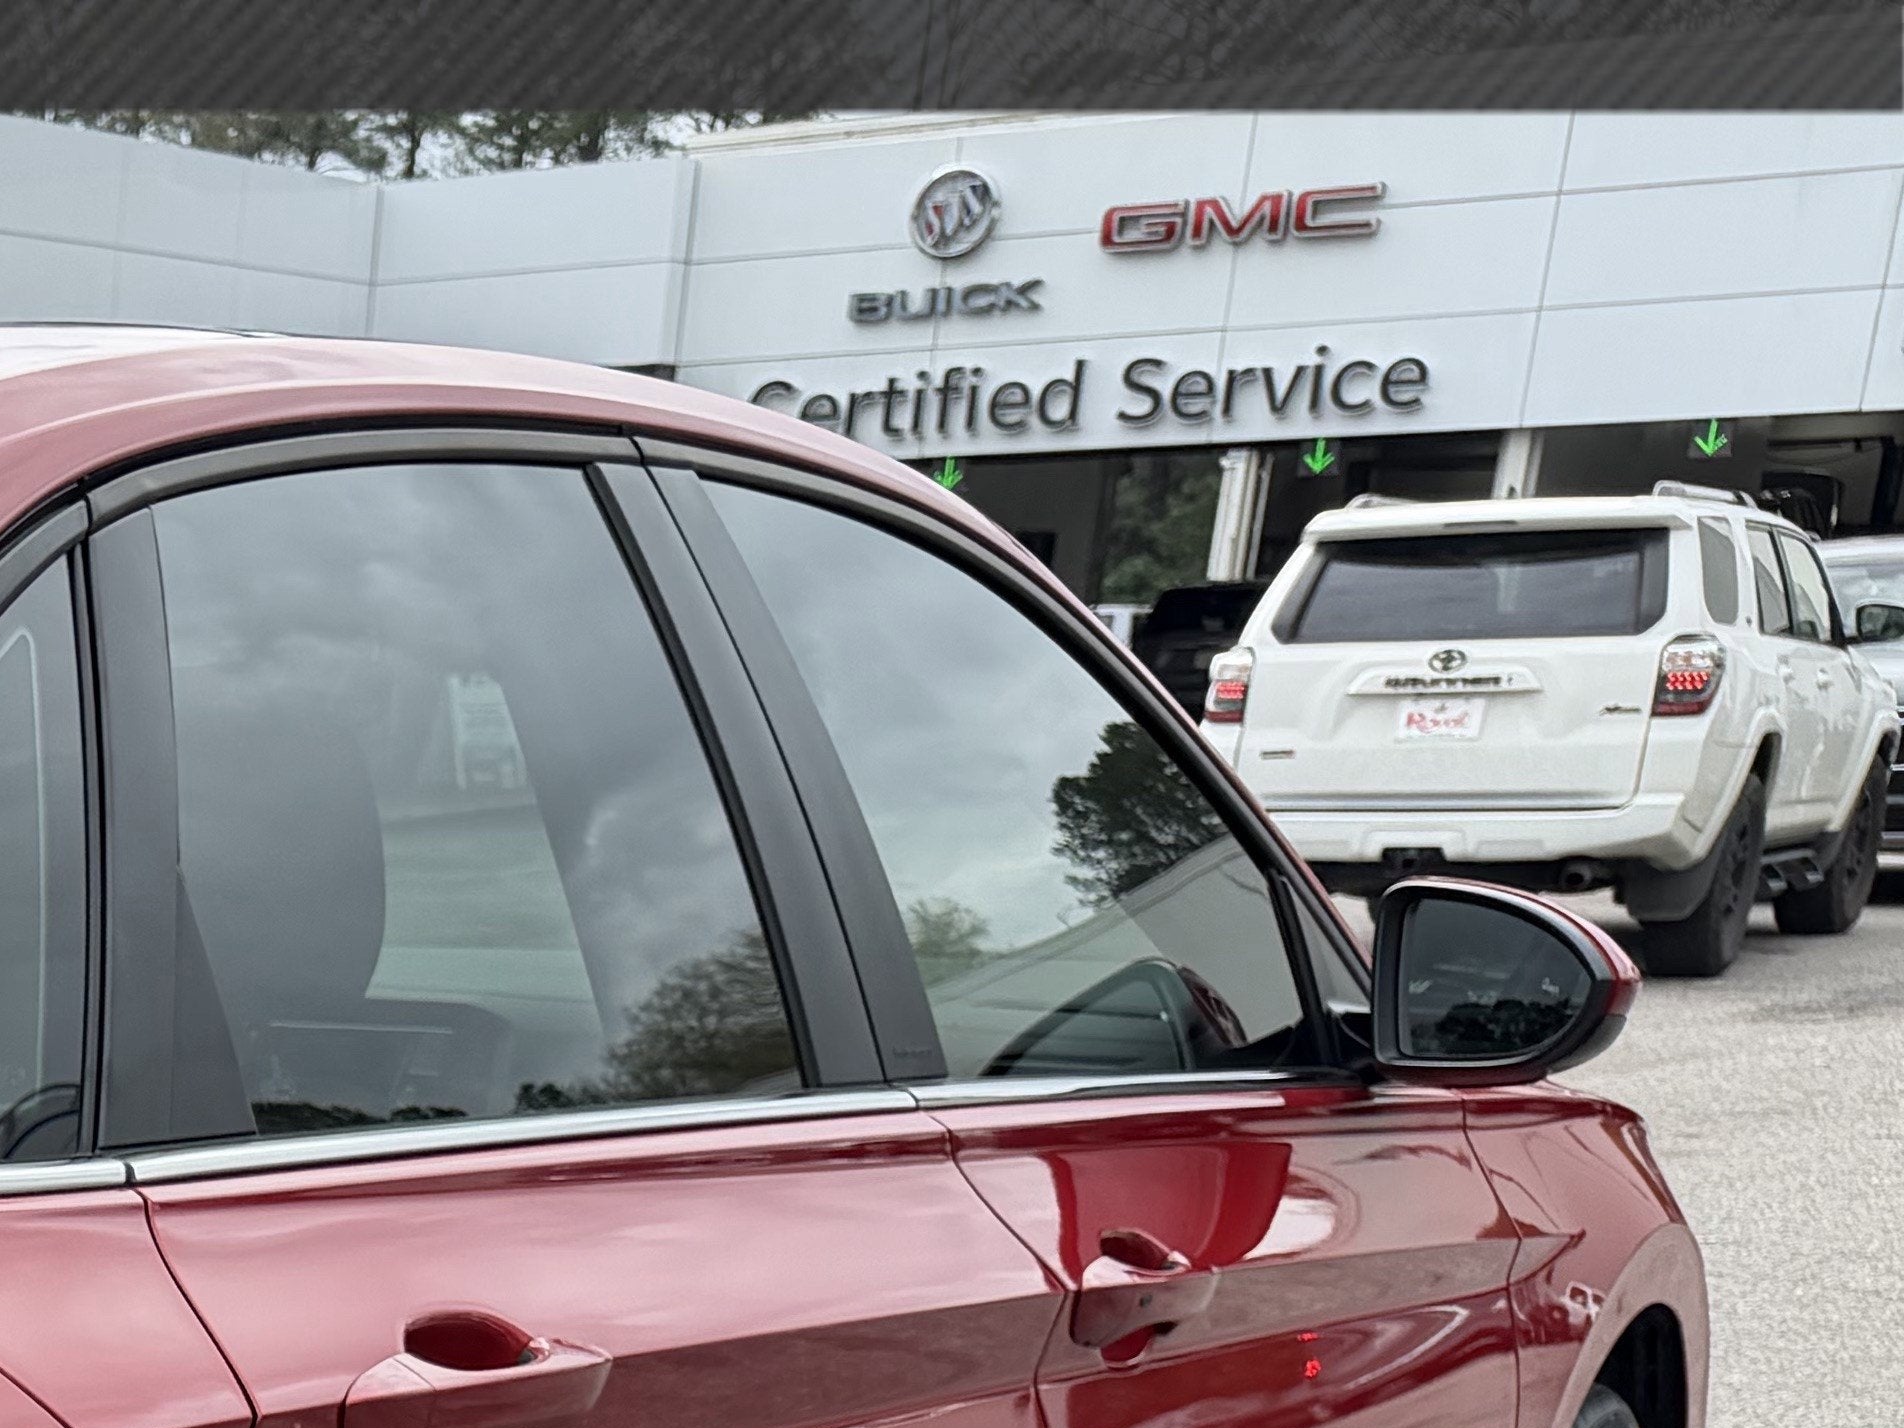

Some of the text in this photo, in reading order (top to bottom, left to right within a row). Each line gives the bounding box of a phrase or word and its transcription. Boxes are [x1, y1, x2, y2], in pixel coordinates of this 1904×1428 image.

[1098, 180, 1387, 254] GMC
[847, 279, 1046, 324] BUICK
[1116, 344, 1431, 426] Service
